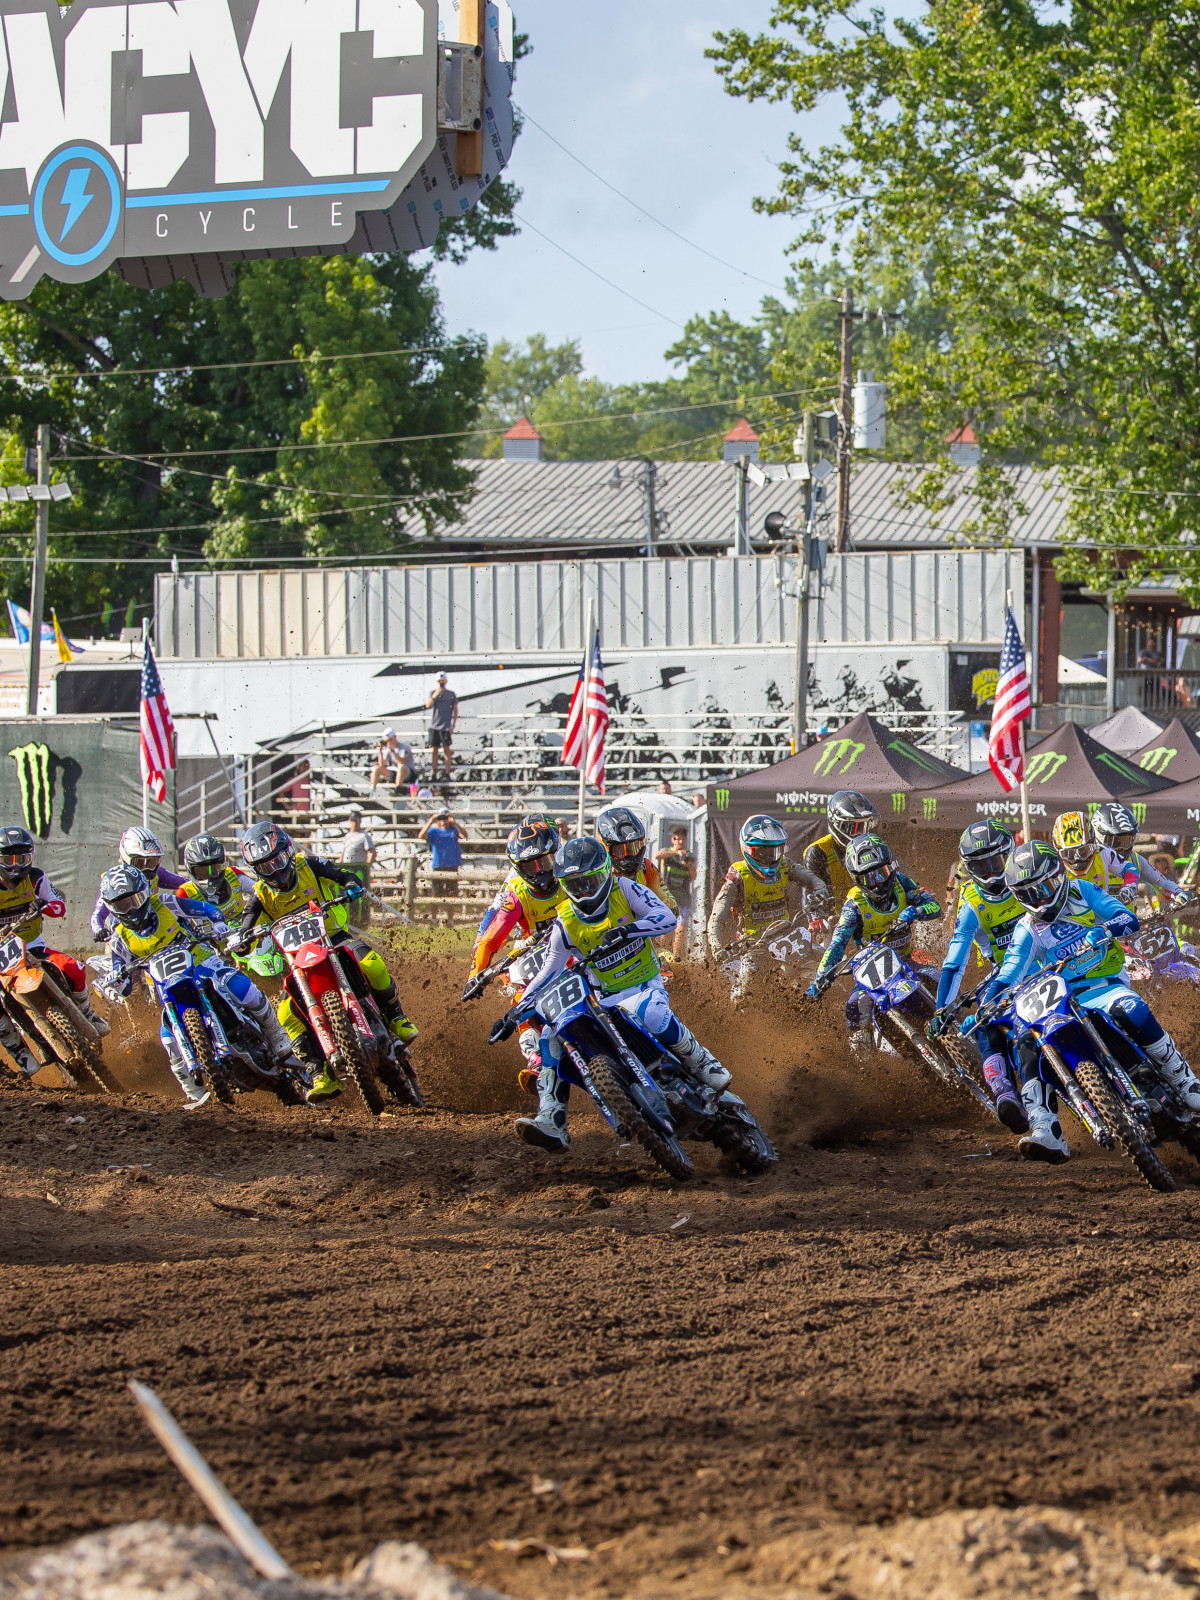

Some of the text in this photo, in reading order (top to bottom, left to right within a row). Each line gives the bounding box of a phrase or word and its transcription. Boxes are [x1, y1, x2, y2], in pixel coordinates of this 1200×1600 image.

[495, 149, 506, 169] DIGITA
[449, 174, 458, 191] PLUS
[155, 202, 343, 238] CYCLE
[977, 684, 997, 706] TEE
[776, 791, 833, 805] MONST
[976, 801, 1047, 816] MONSER
[155, 951, 187, 980] 12
[595, 937, 644, 969] CHAMPIONSHIP
[861, 950, 893, 990] 17
[1022, 979, 1064, 1021] 32
[627, 1056, 651, 1087] DUNLOP
